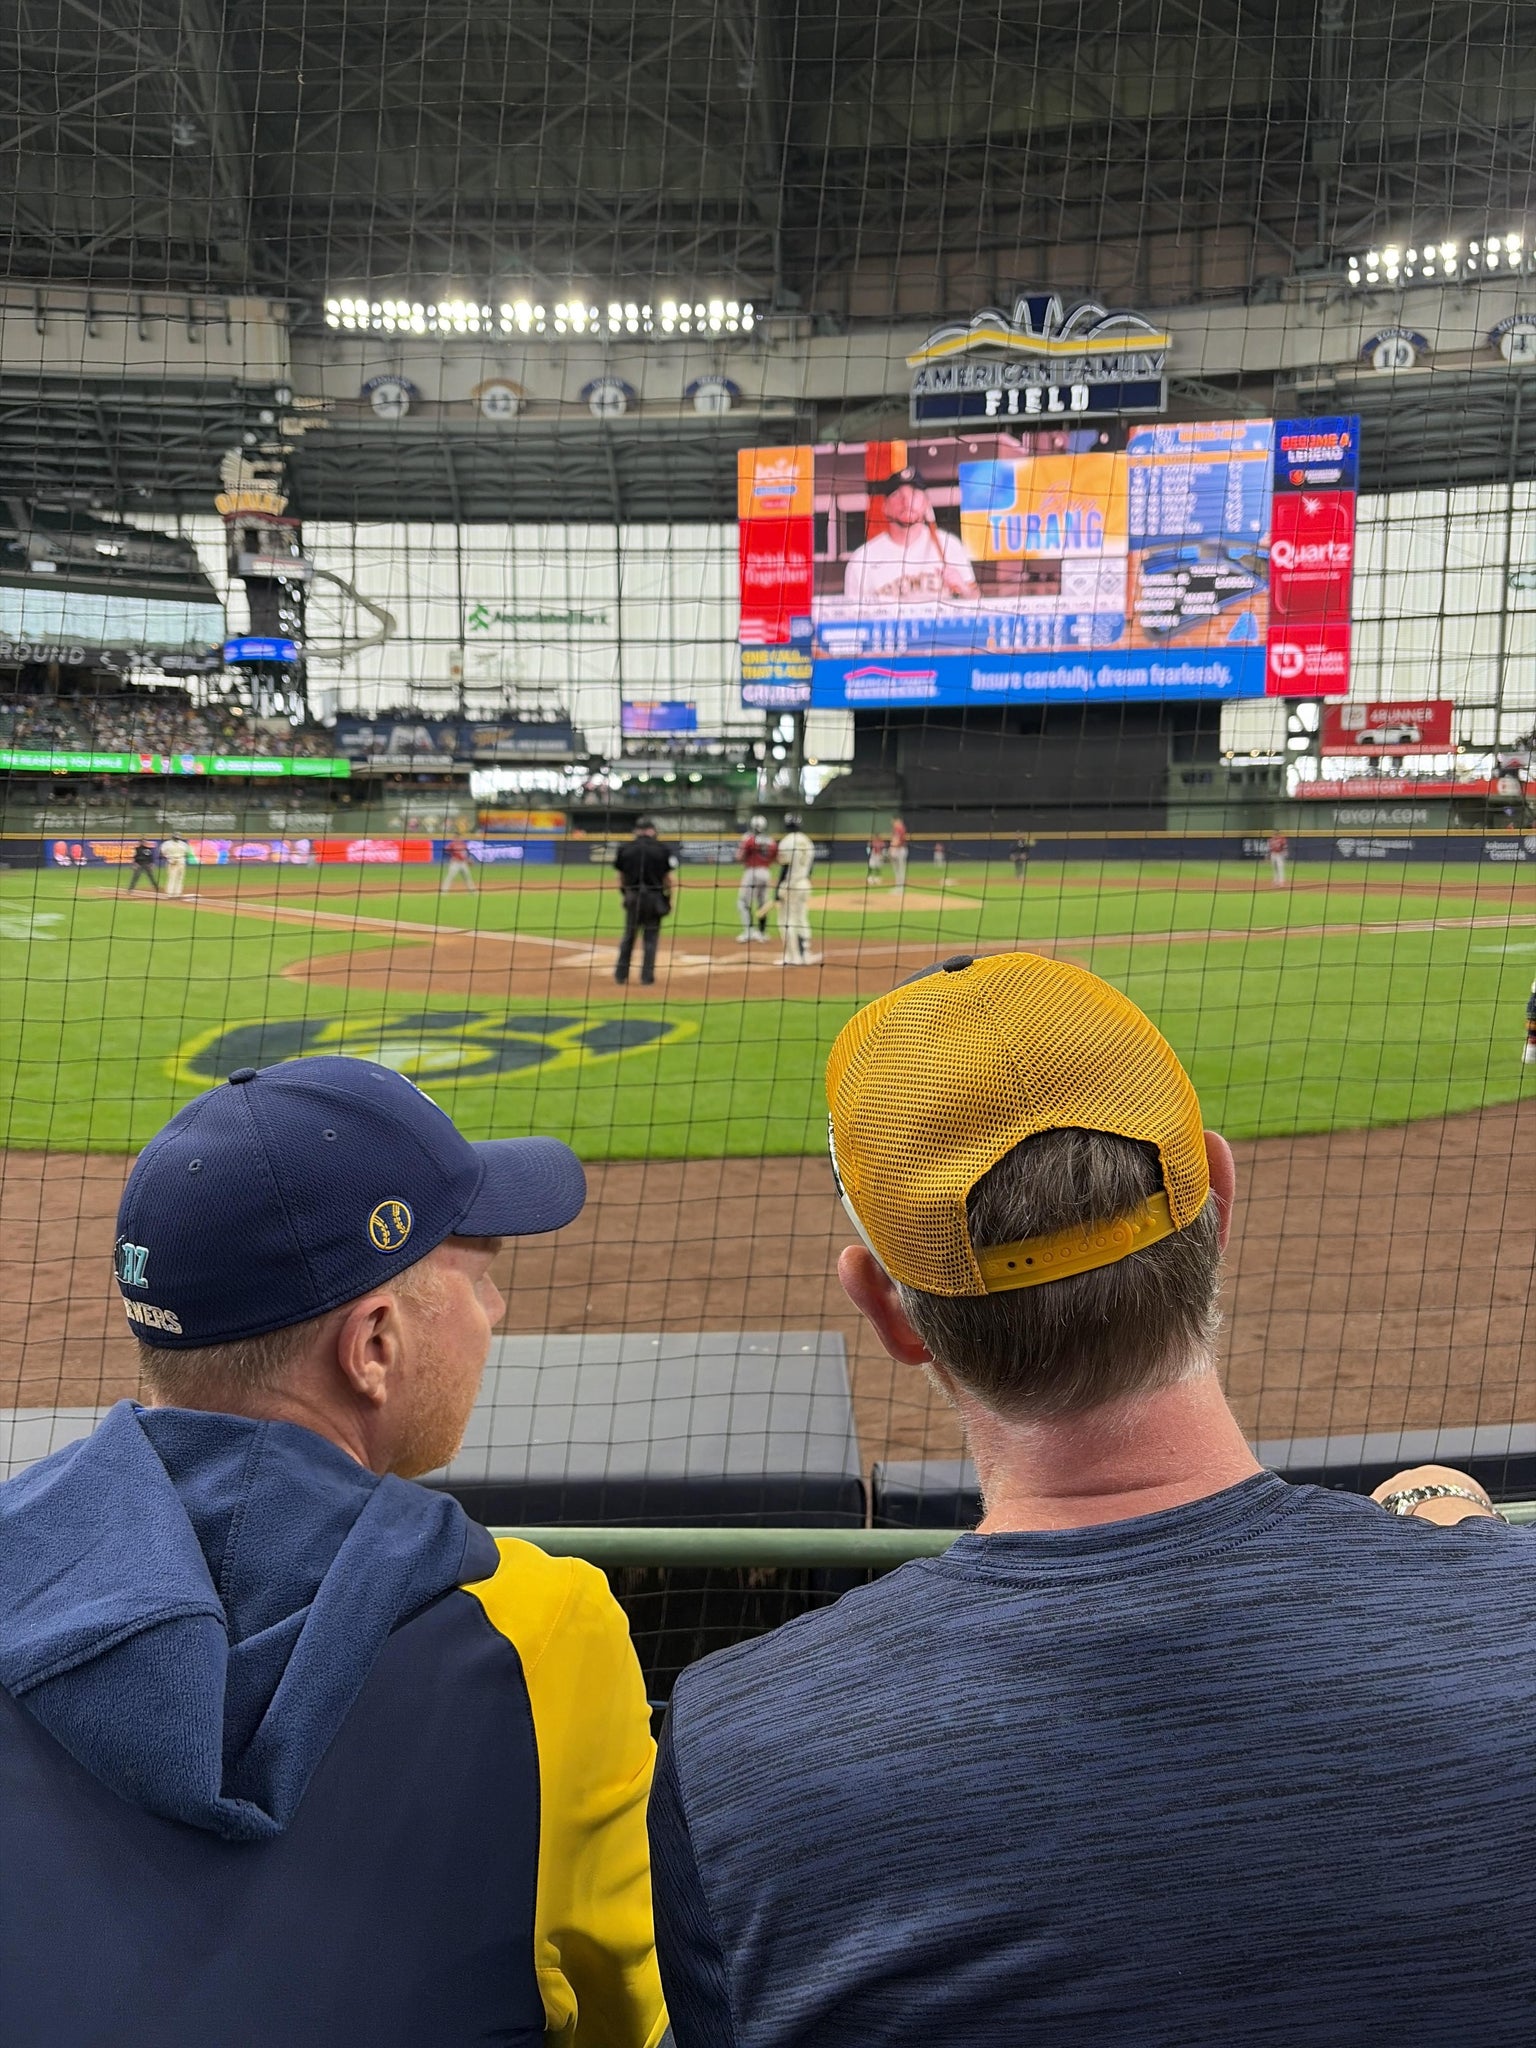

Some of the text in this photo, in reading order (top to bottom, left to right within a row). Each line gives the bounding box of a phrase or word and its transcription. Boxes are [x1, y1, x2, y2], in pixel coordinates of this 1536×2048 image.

[916, 353, 1166, 390] AMERICAN FAMILY
[985, 384, 1089, 416] FIELD
[989, 510, 1102, 551] TURANG
[1271, 540, 1350, 569] Quartz
[1097, 665, 1148, 687] dream
[1370, 707, 1434, 722] 4RUNNER
[122, 1243, 150, 1289] AZ
